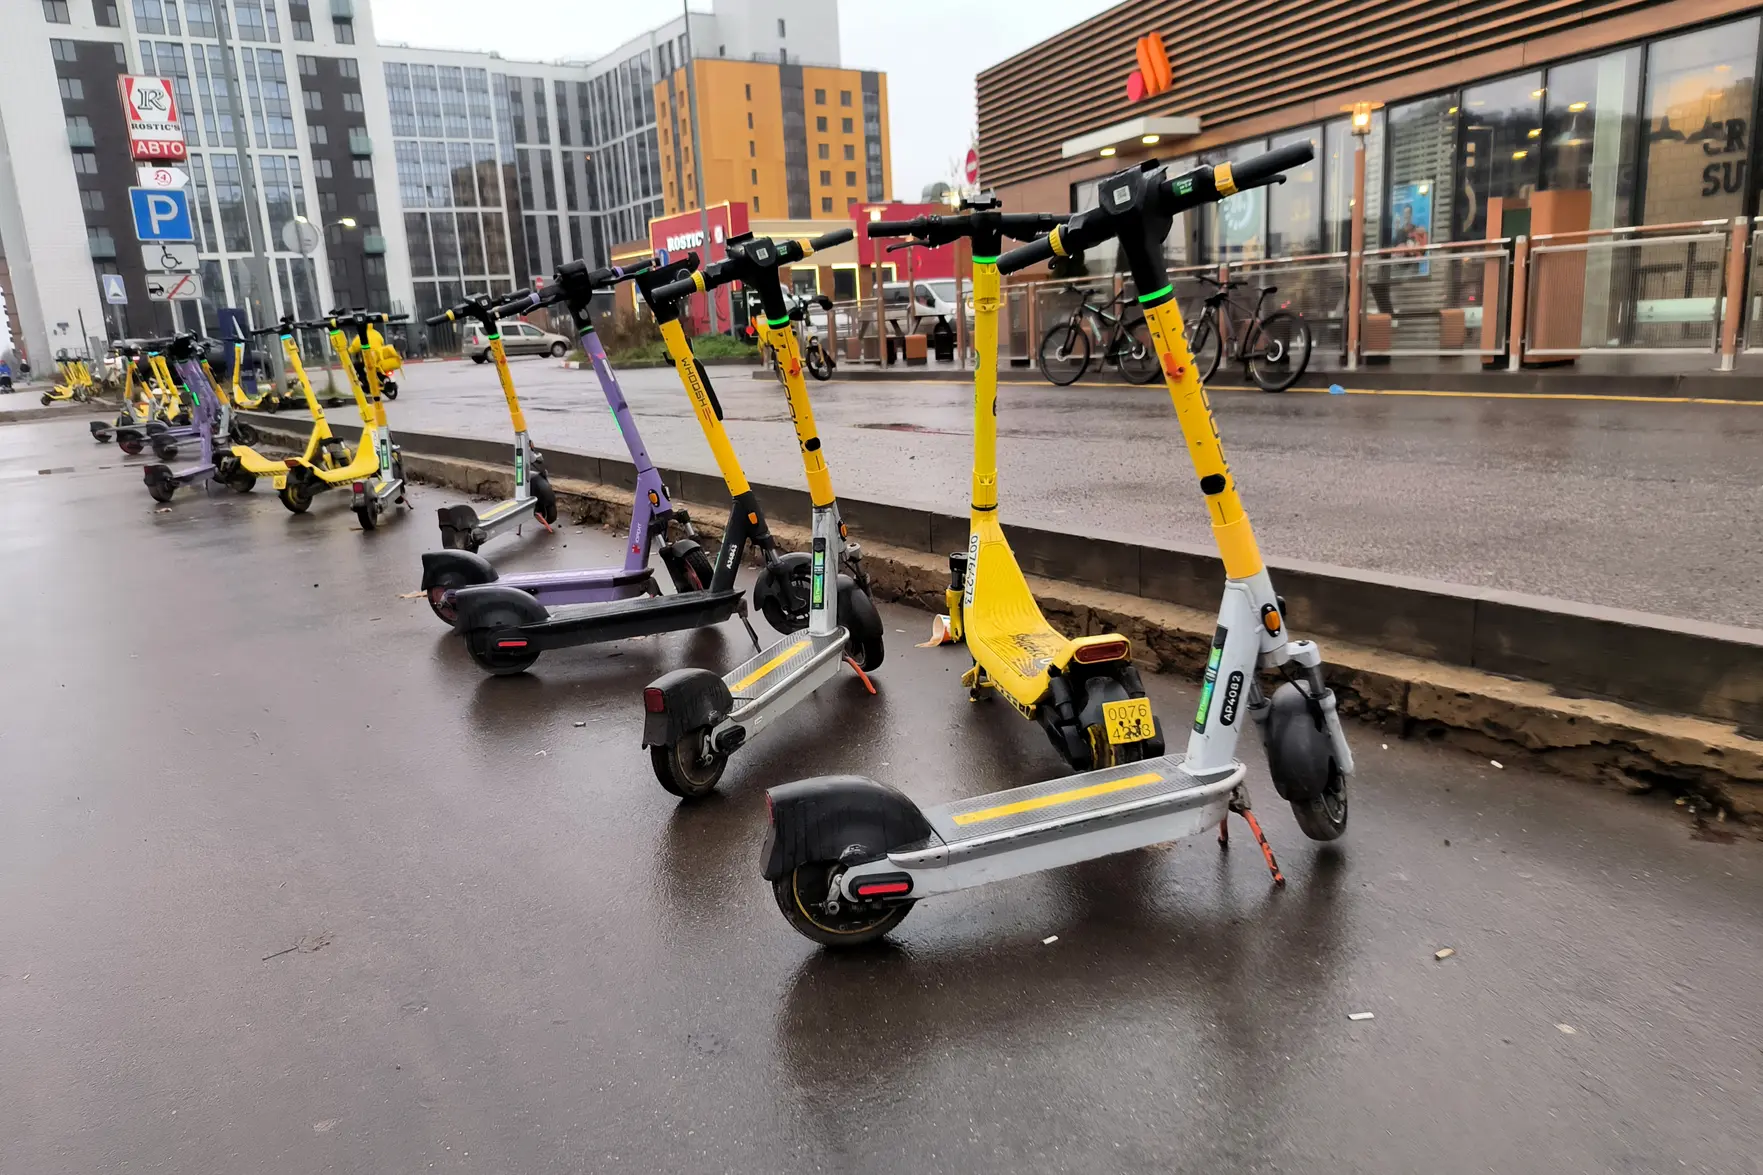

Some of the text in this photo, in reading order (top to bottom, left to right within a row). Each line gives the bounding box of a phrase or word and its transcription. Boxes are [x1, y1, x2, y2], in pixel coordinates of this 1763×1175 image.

[131, 123, 180, 131] ROSTIC'S
[136, 141, 184, 155] АВТО
[147, 194, 178, 235] P
[666, 229, 711, 252] ROSTIC'
[680, 356, 707, 407] WHOOSH
[1223, 674, 1241, 722] AP4082
[1108, 703, 1148, 721] 0076
